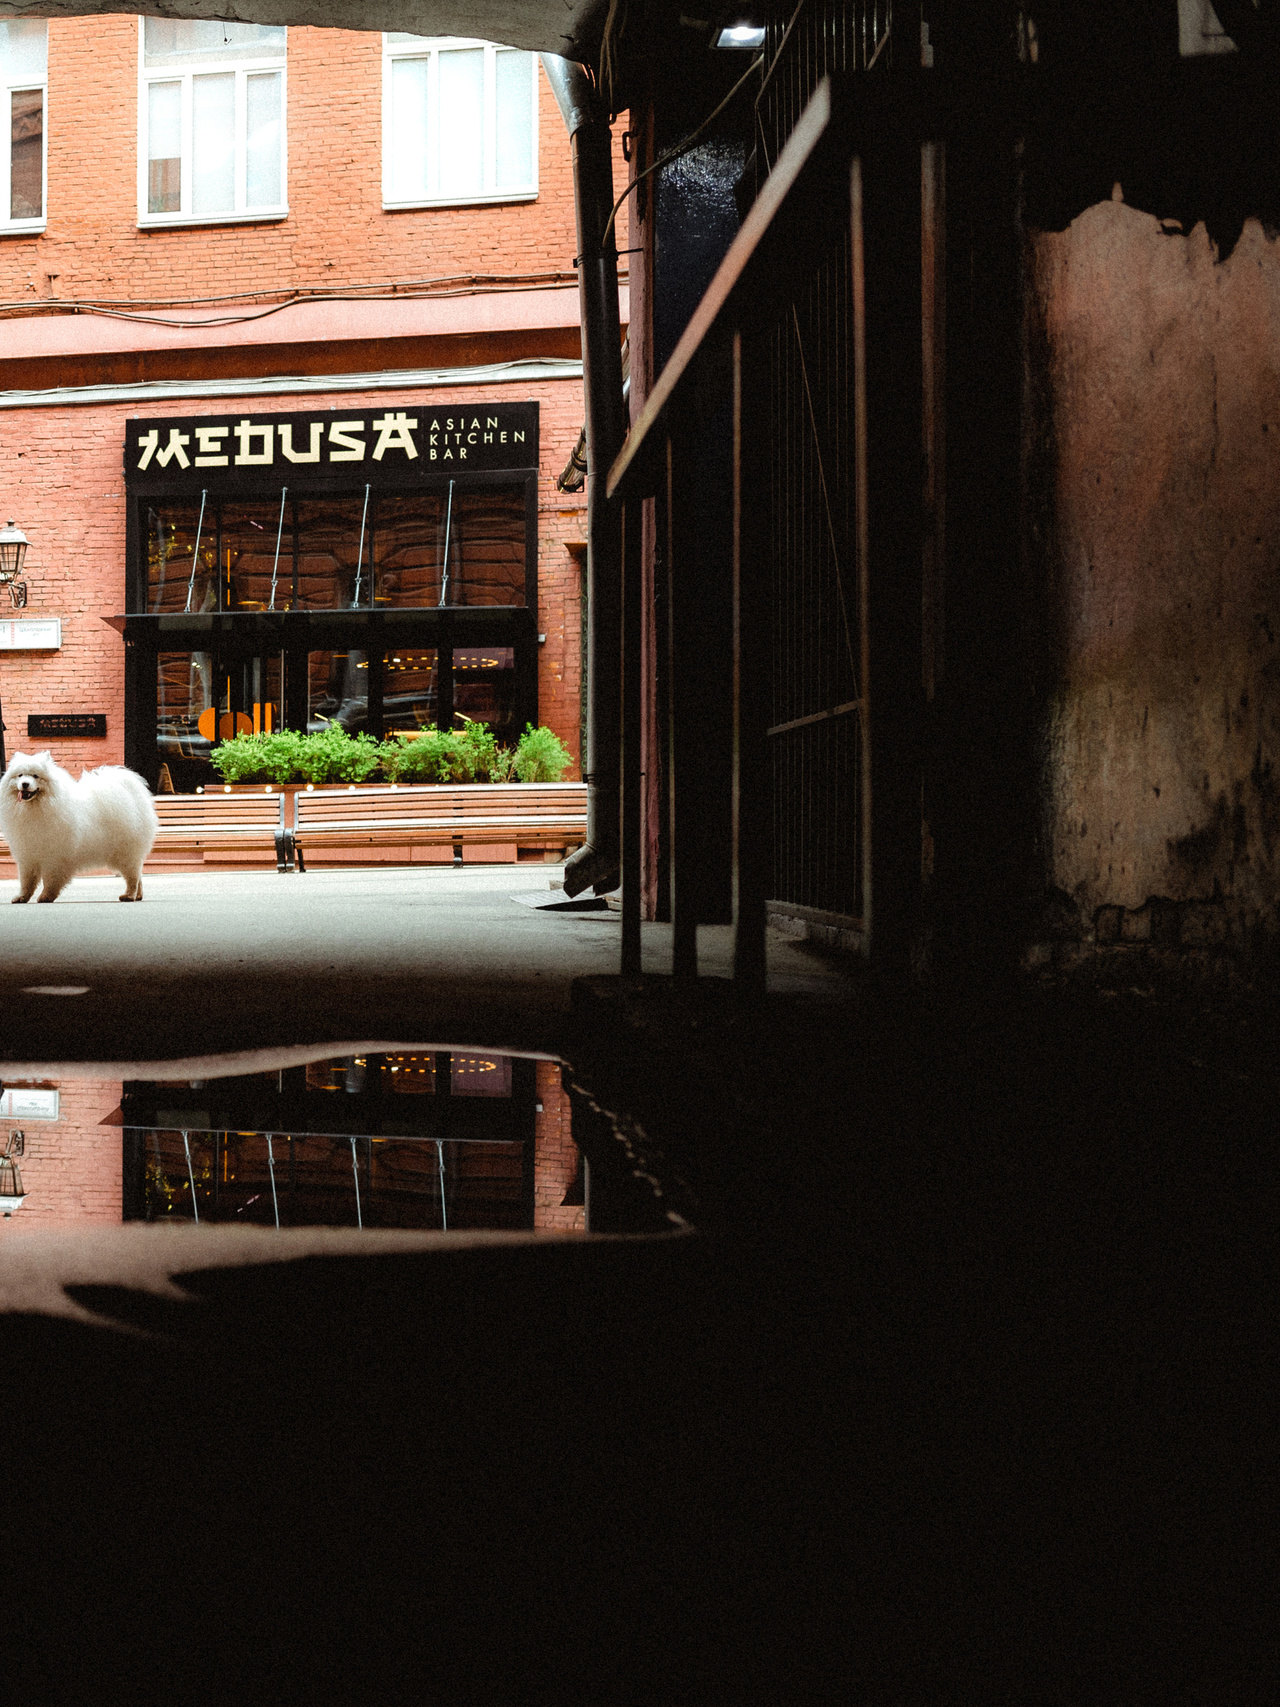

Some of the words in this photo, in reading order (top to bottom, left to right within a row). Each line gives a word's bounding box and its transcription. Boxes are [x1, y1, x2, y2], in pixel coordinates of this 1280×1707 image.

[430, 417, 499, 431] ASIAN
[138, 412, 419, 471] MEDUSA
[430, 430, 526, 446] KITCHEN
[430, 447, 468, 461] BAR
